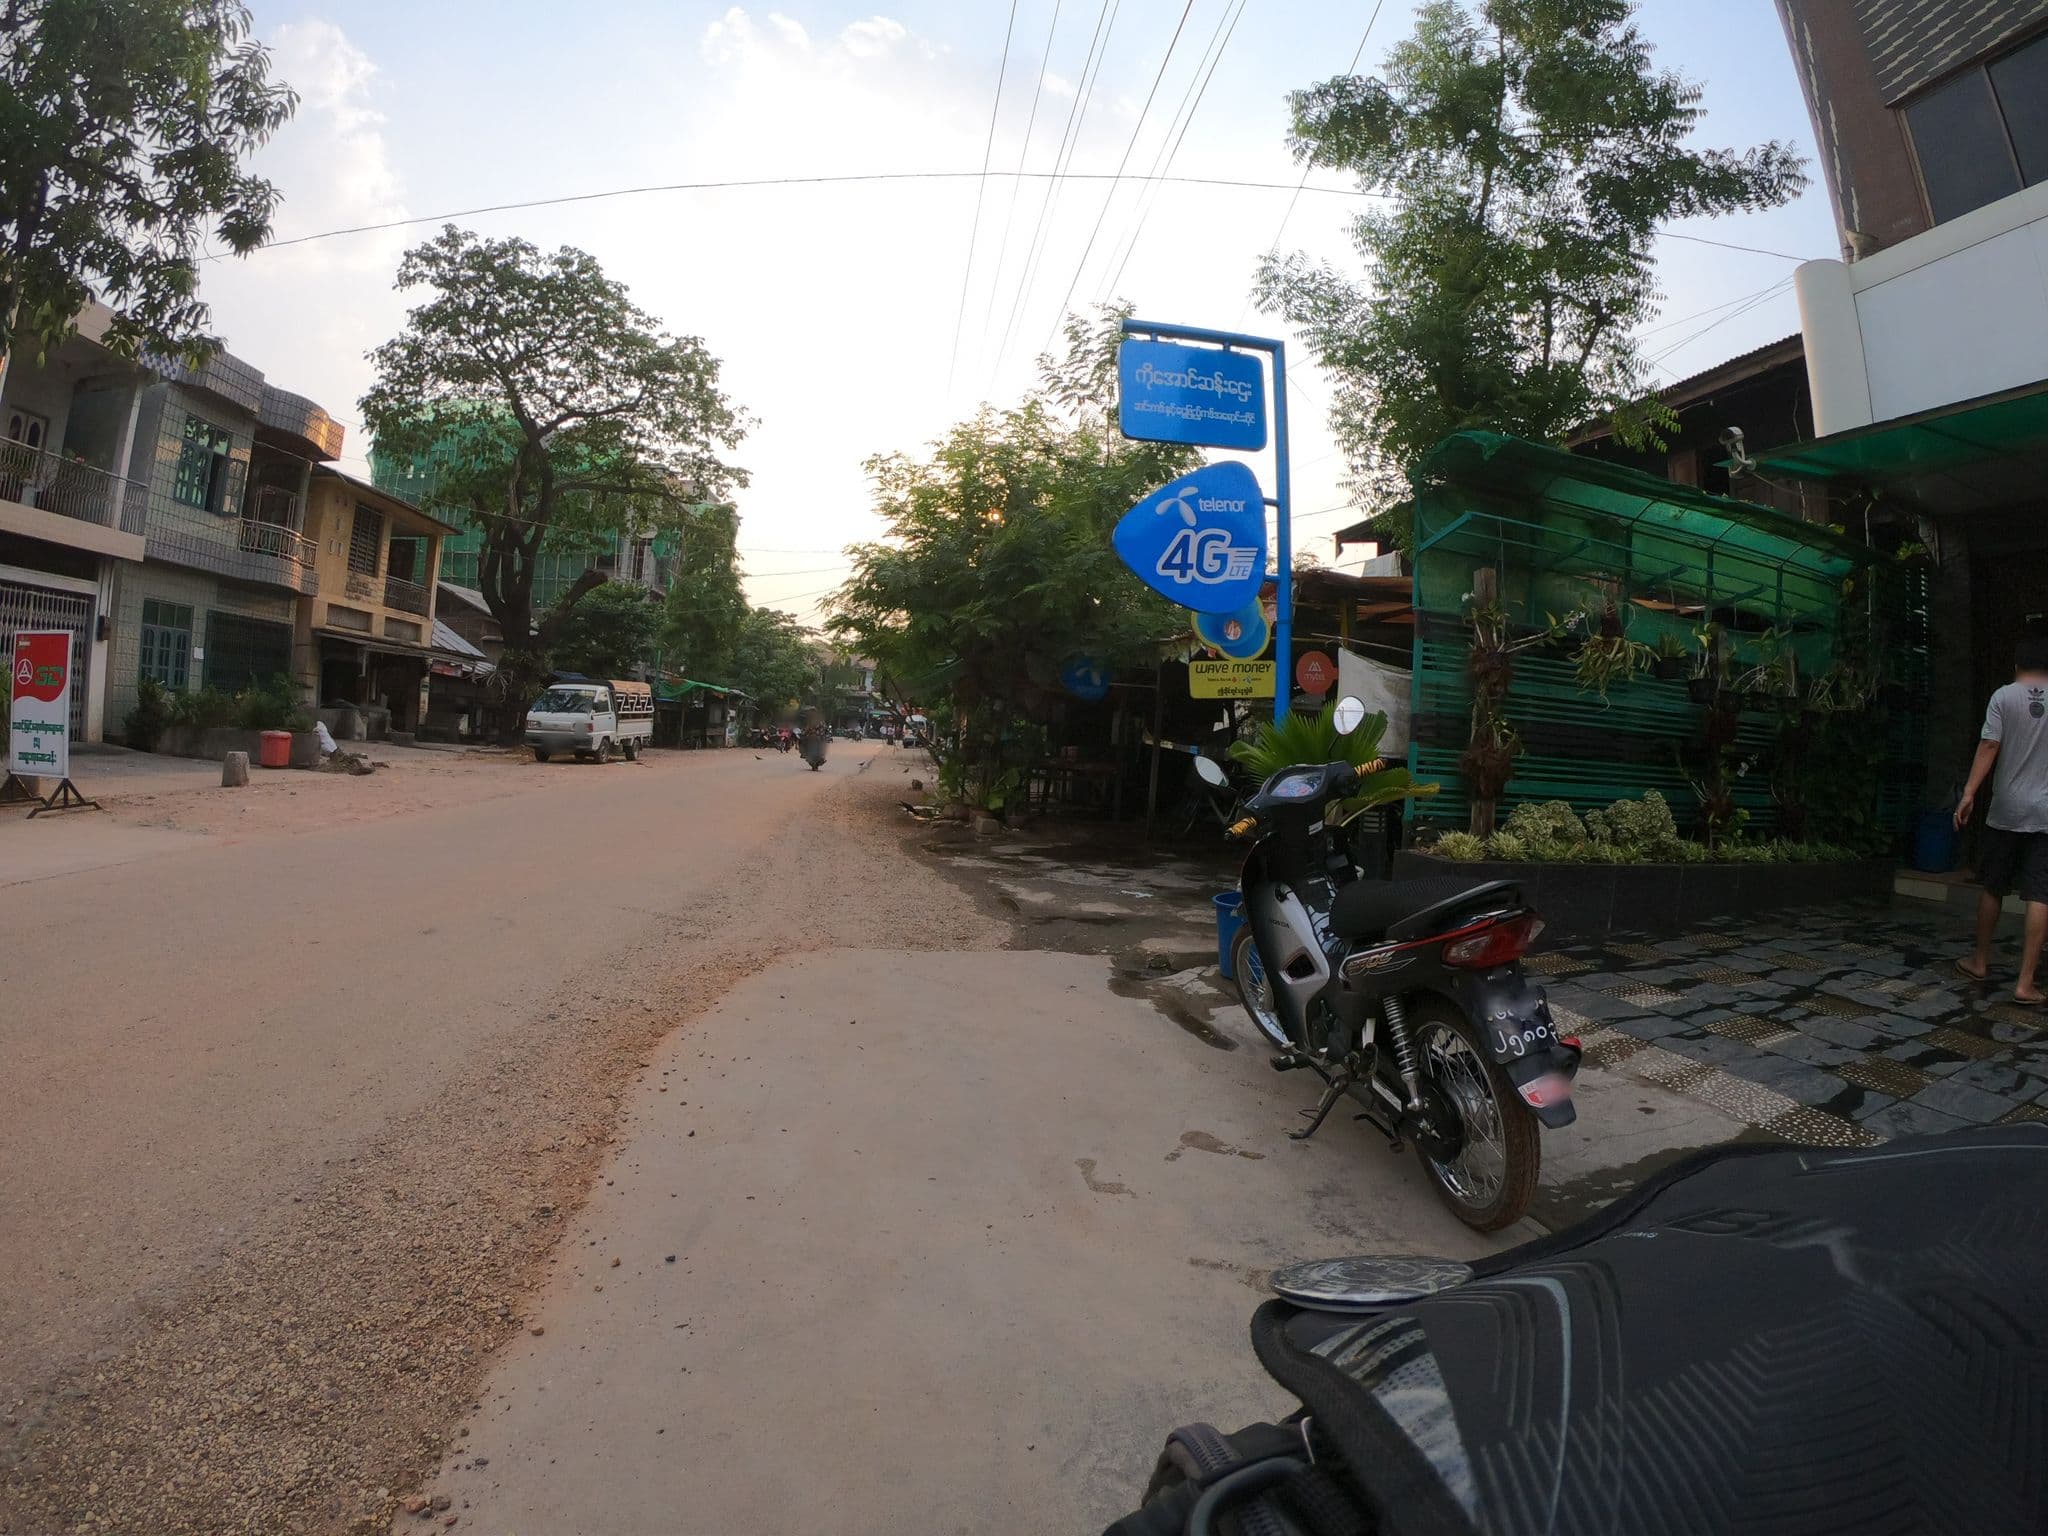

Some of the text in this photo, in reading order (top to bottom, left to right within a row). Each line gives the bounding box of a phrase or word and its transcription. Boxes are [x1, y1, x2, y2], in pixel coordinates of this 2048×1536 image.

[1199, 497, 1247, 513] telenor
[1158, 530, 1250, 582] 4G LTE
